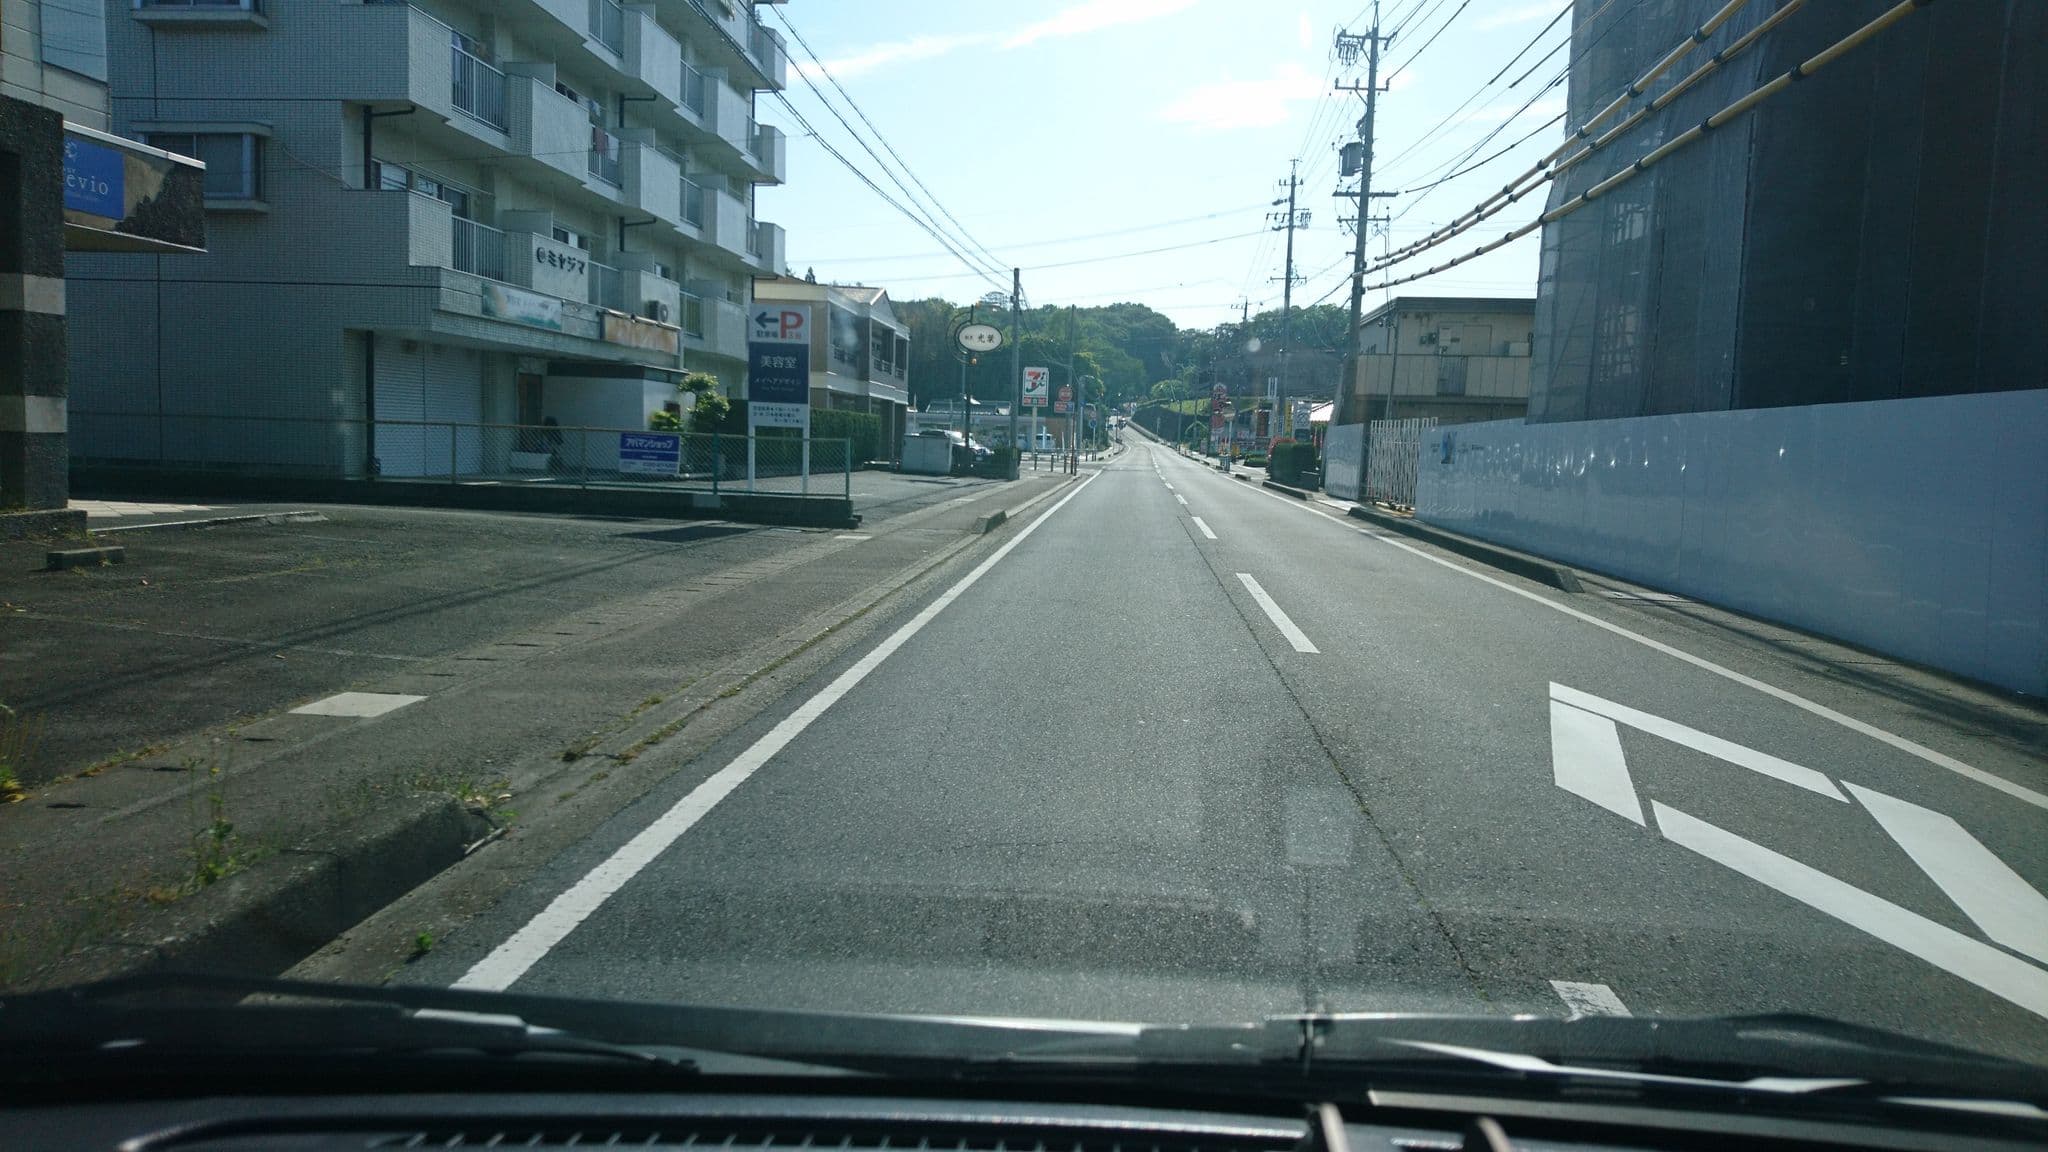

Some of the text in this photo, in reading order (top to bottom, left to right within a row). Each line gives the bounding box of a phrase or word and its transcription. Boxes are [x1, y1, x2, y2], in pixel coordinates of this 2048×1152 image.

[548, 250, 586, 274] ミヤジマ
[780, 311, 804, 339] P
[760, 355, 798, 369] 美容室
